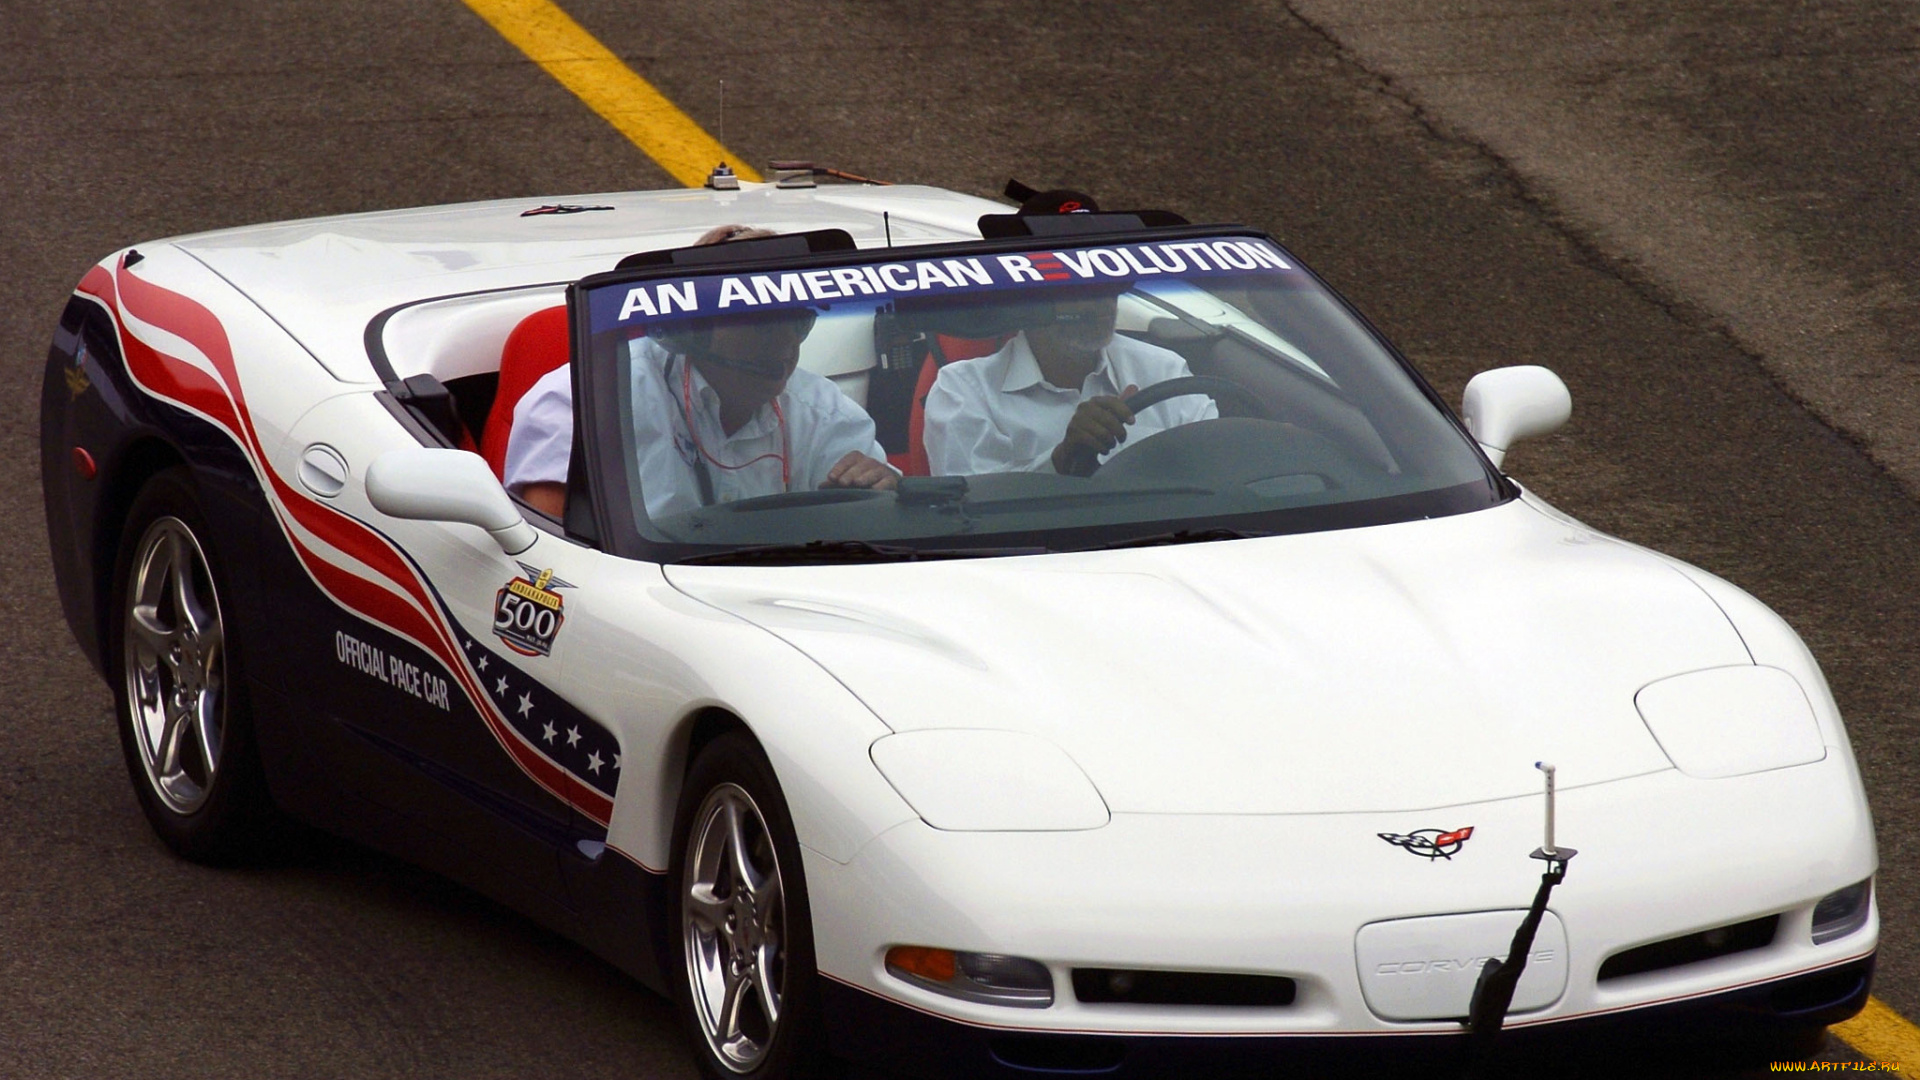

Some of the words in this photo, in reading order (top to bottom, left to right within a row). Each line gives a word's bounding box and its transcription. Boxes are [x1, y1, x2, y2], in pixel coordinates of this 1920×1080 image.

[618, 281, 699, 321] AN
[718, 258, 994, 308] AMERICAN
[996, 241, 1292, 283] REVOLUTION
[495, 593, 555, 639] 500
[512, 582, 558, 608] INDIANAPOLIS
[335, 630, 389, 683] OFFICIAL
[389, 655, 422, 698] PACE
[423, 671, 451, 712] CAR
[1375, 949, 1555, 976] CORVEE
